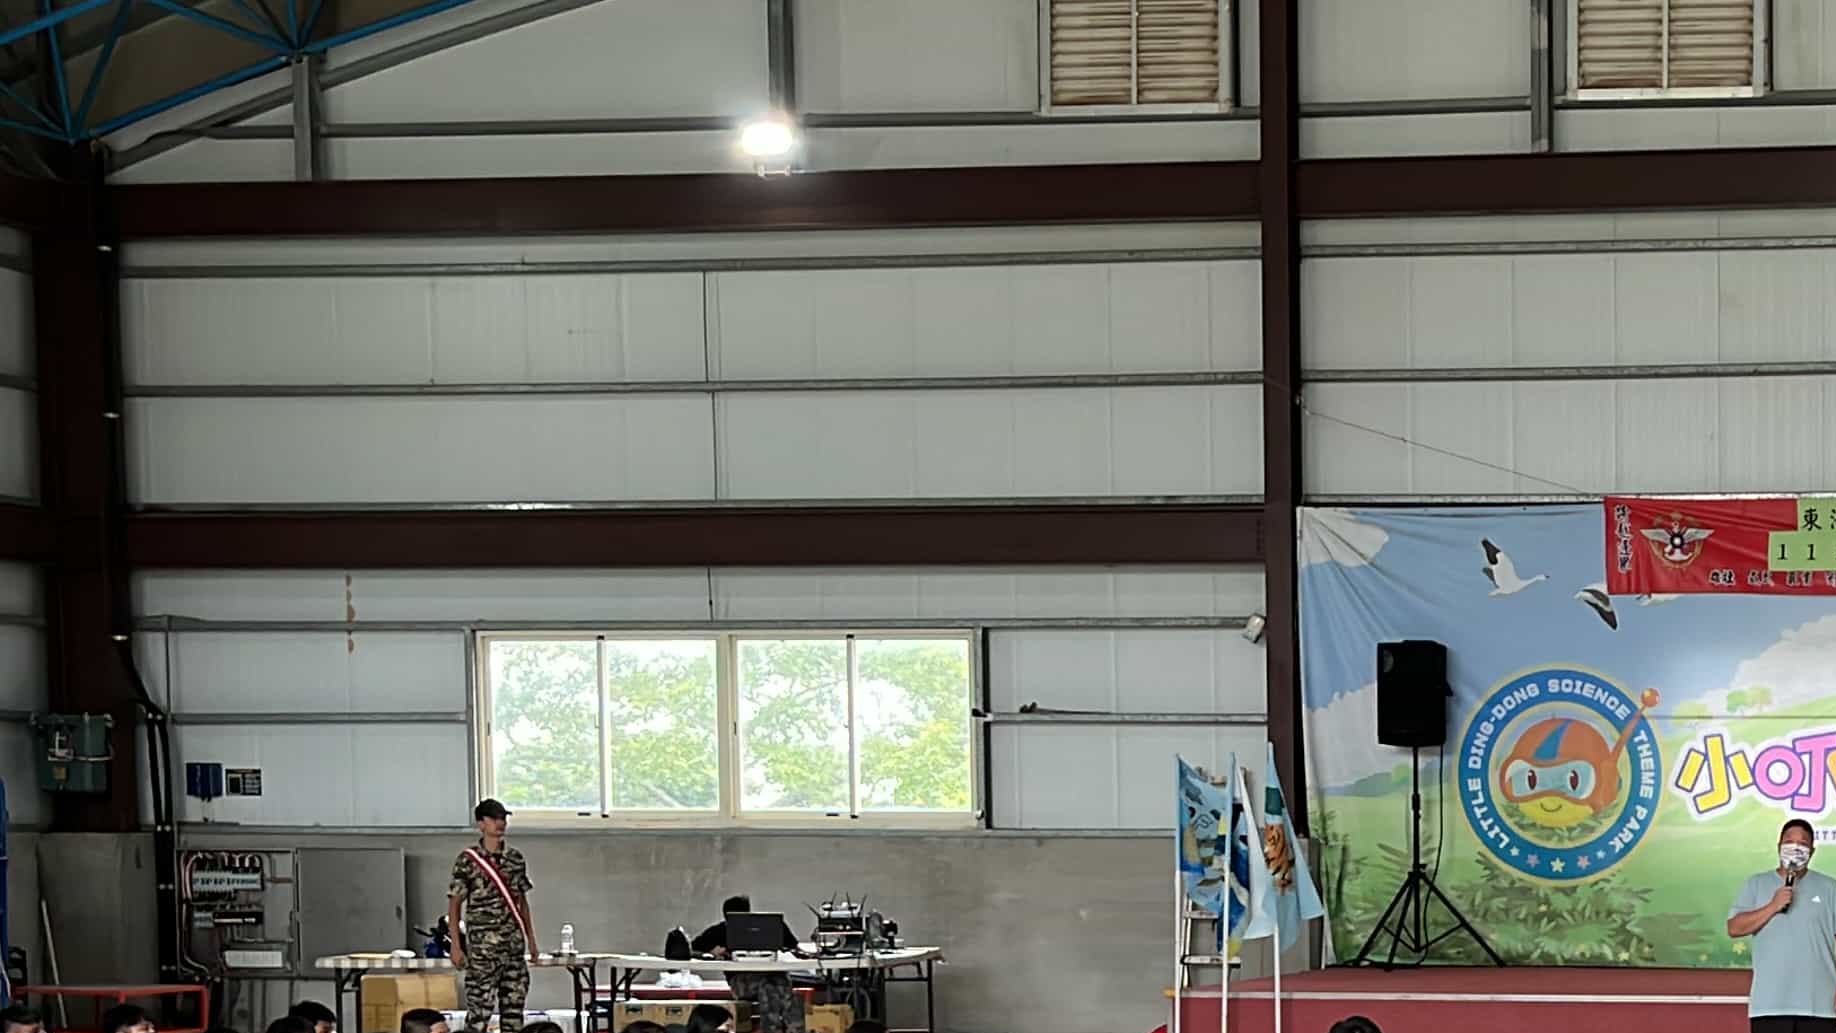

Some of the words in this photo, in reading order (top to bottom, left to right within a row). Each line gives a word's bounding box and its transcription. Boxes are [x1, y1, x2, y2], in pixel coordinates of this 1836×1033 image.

[1468, 683, 1540, 769] DING-DONG
[1547, 679, 1632, 720] SCIENCE
[1633, 730, 1656, 800] THEME
[1468, 778, 1510, 849] LITTLE
[1610, 805, 1648, 854] PARK
